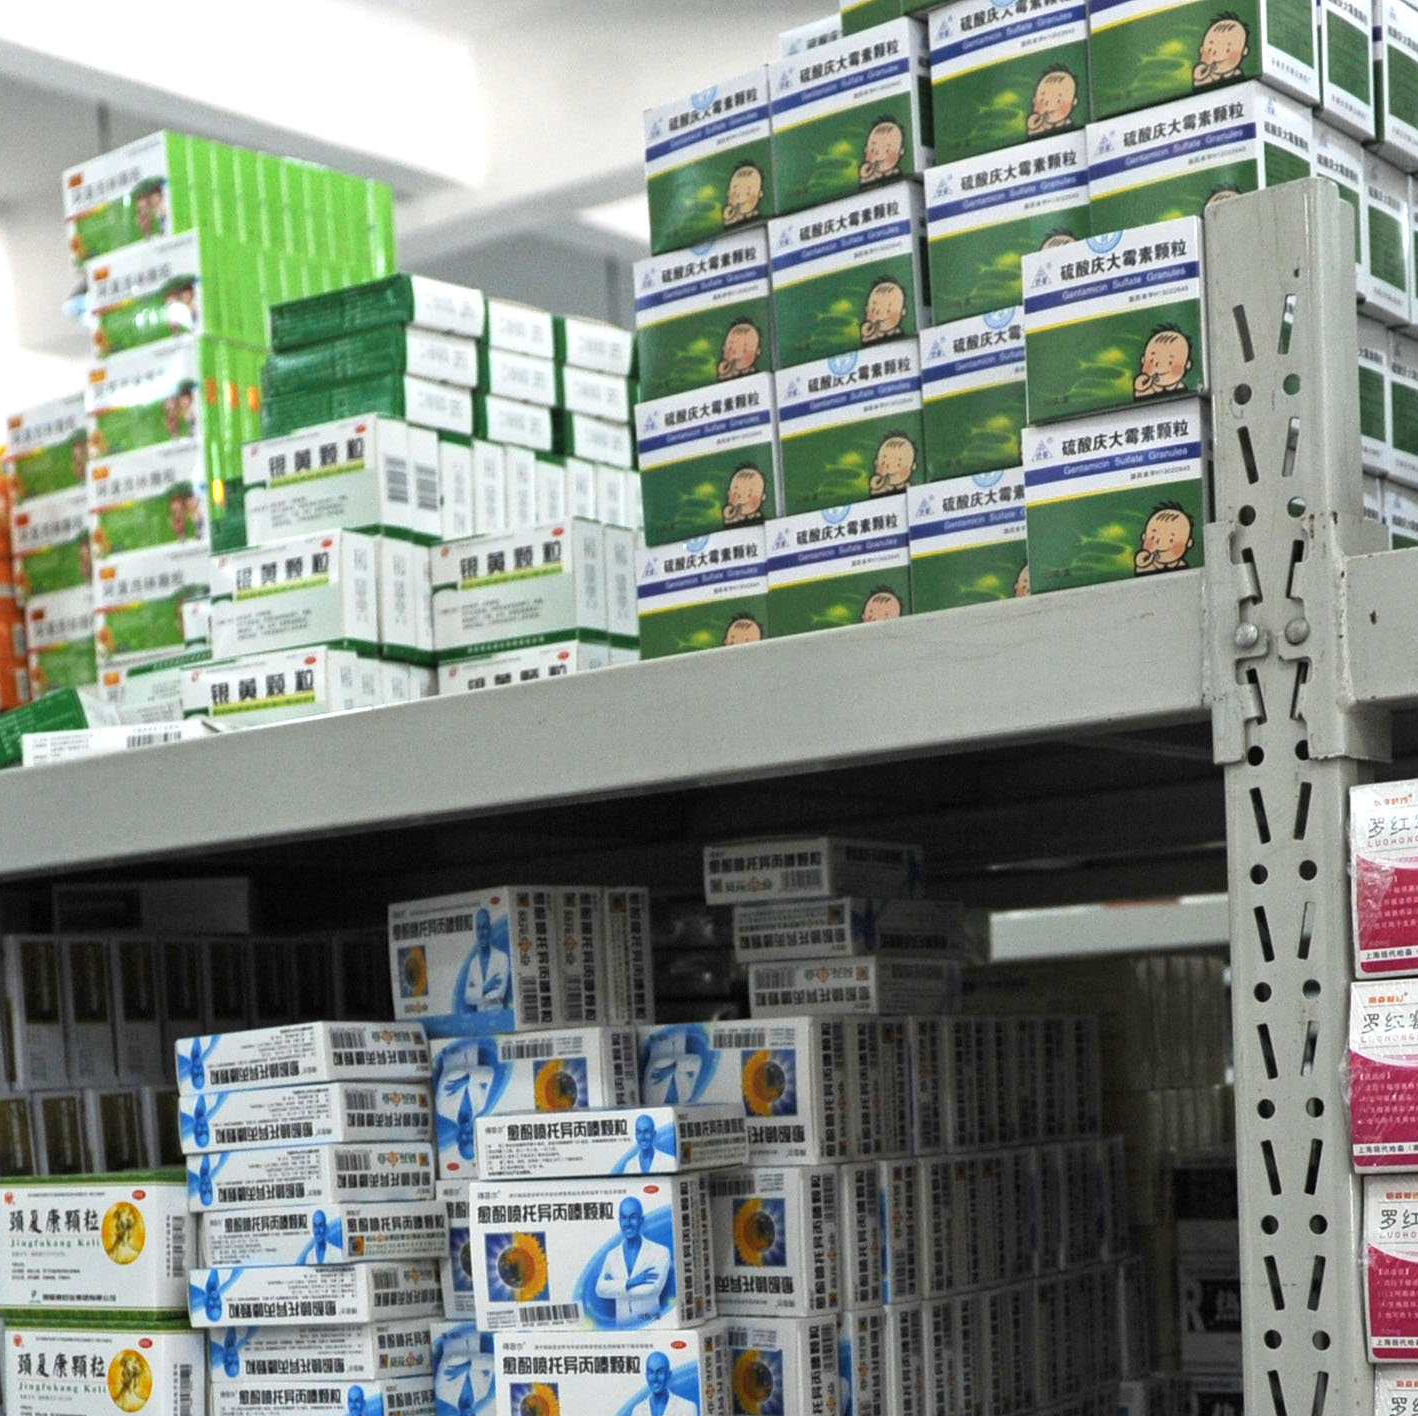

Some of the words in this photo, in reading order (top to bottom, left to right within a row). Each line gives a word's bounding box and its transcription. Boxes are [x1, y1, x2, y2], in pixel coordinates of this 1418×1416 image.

[1123, 101, 1245, 147] 硫酸庆大霉素颗粒
[960, 150, 1078, 191] 硫酸庆大霉素颗粒
[1061, 239, 1188, 282] 硫酸庆大霉素颗粒
[1112, 275, 1141, 289] Sulfate
[1146, 267, 1185, 282] Granules
[953, 325, 1024, 354] 硫酸庆大霉
[1062, 419, 1189, 457] 硫酸庆大霉素颗粒
[1115, 453, 1143, 466] Sulfate
[1149, 447, 1188, 460] Granules
[942, 486, 1025, 512] 硫酸庆大霉素
[477, 1202, 614, 1224] 愈酚喷托异丙嗪颗粒
[503, 1356, 641, 1375] 愈酚喷托异丙嗪颗粒
